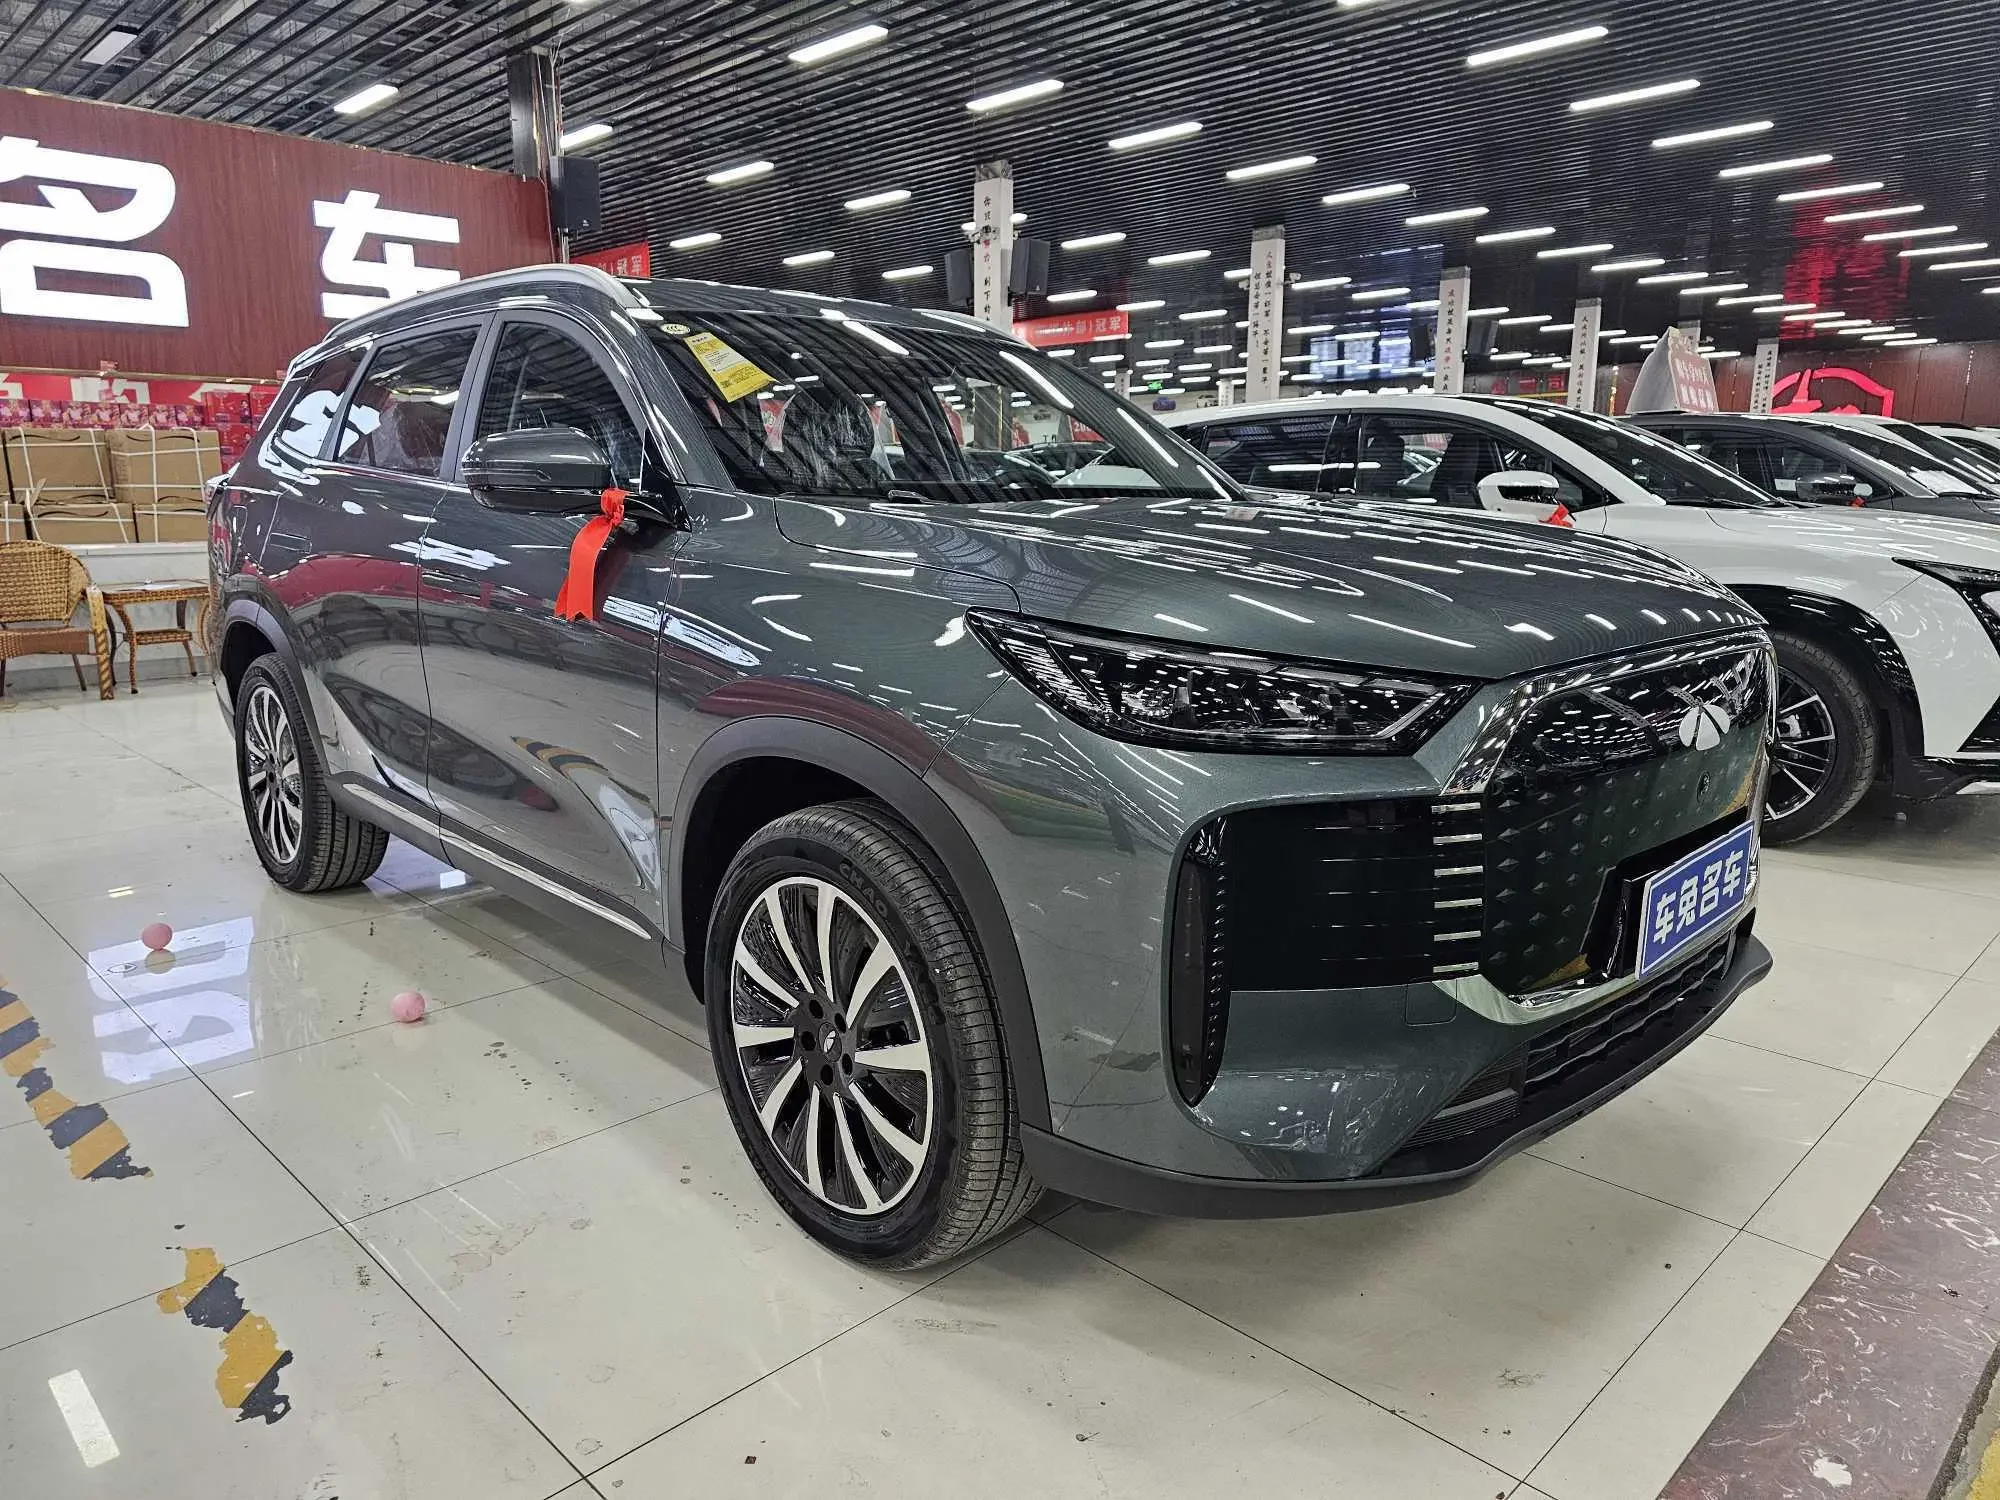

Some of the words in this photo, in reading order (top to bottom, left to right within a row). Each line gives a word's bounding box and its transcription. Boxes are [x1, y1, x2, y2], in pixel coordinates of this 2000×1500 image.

[0, 136, 461, 327] 名车
[1653, 850, 1744, 945] 车兔名车
